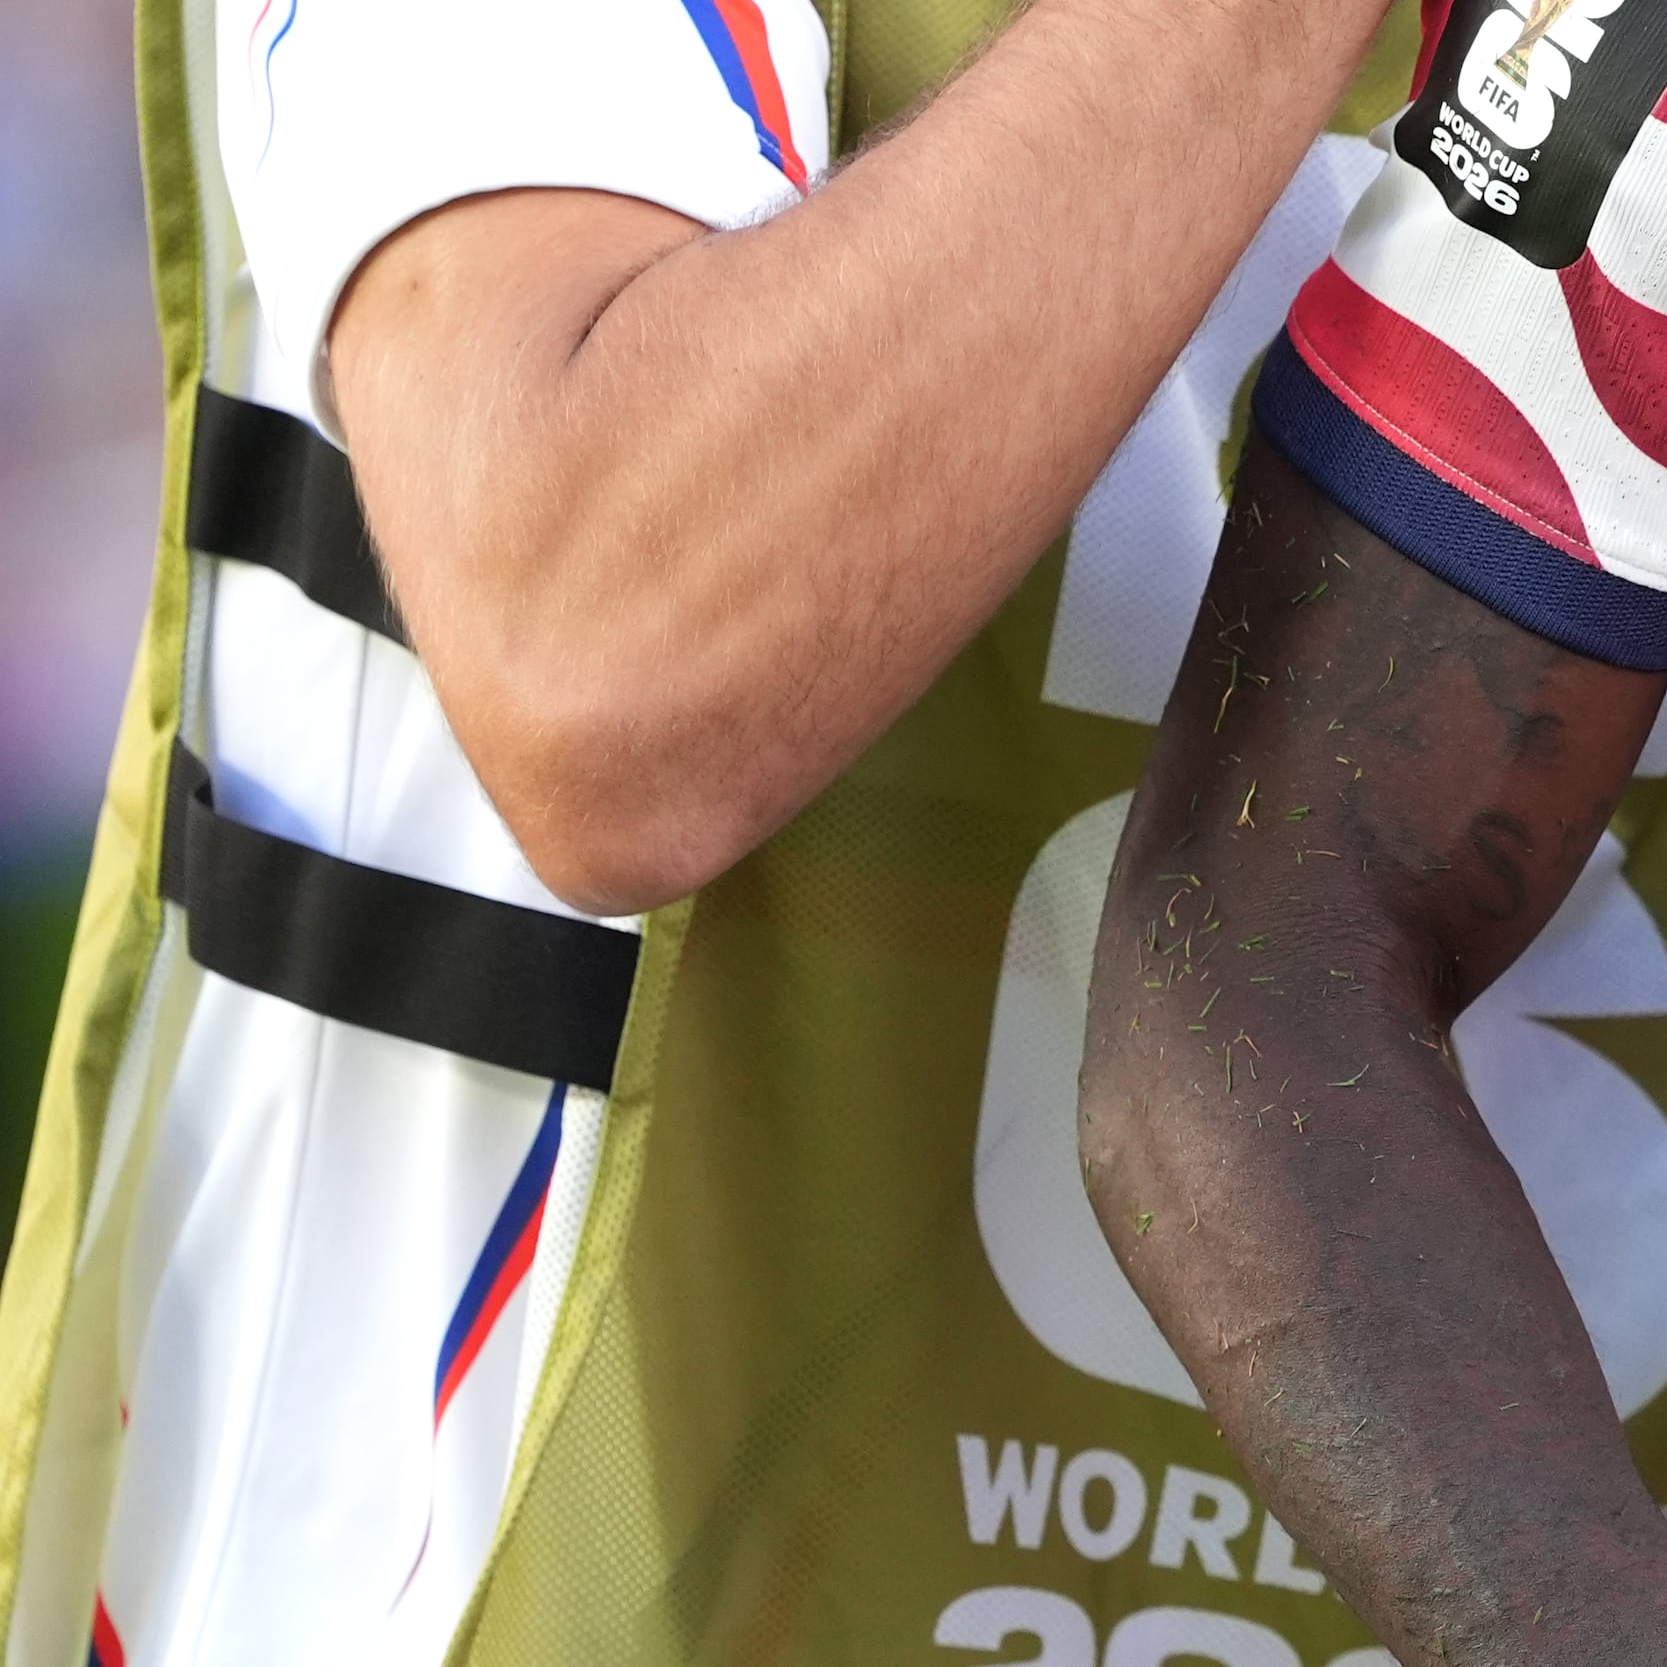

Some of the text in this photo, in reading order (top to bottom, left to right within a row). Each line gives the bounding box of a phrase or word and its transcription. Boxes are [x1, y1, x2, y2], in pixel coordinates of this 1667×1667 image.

[1478, 75, 1520, 123] FIFA
[1430, 126, 1520, 215] 2026
[1439, 101, 1530, 184] WORLD CUP
[956, 1433, 1330, 1596] WORL
